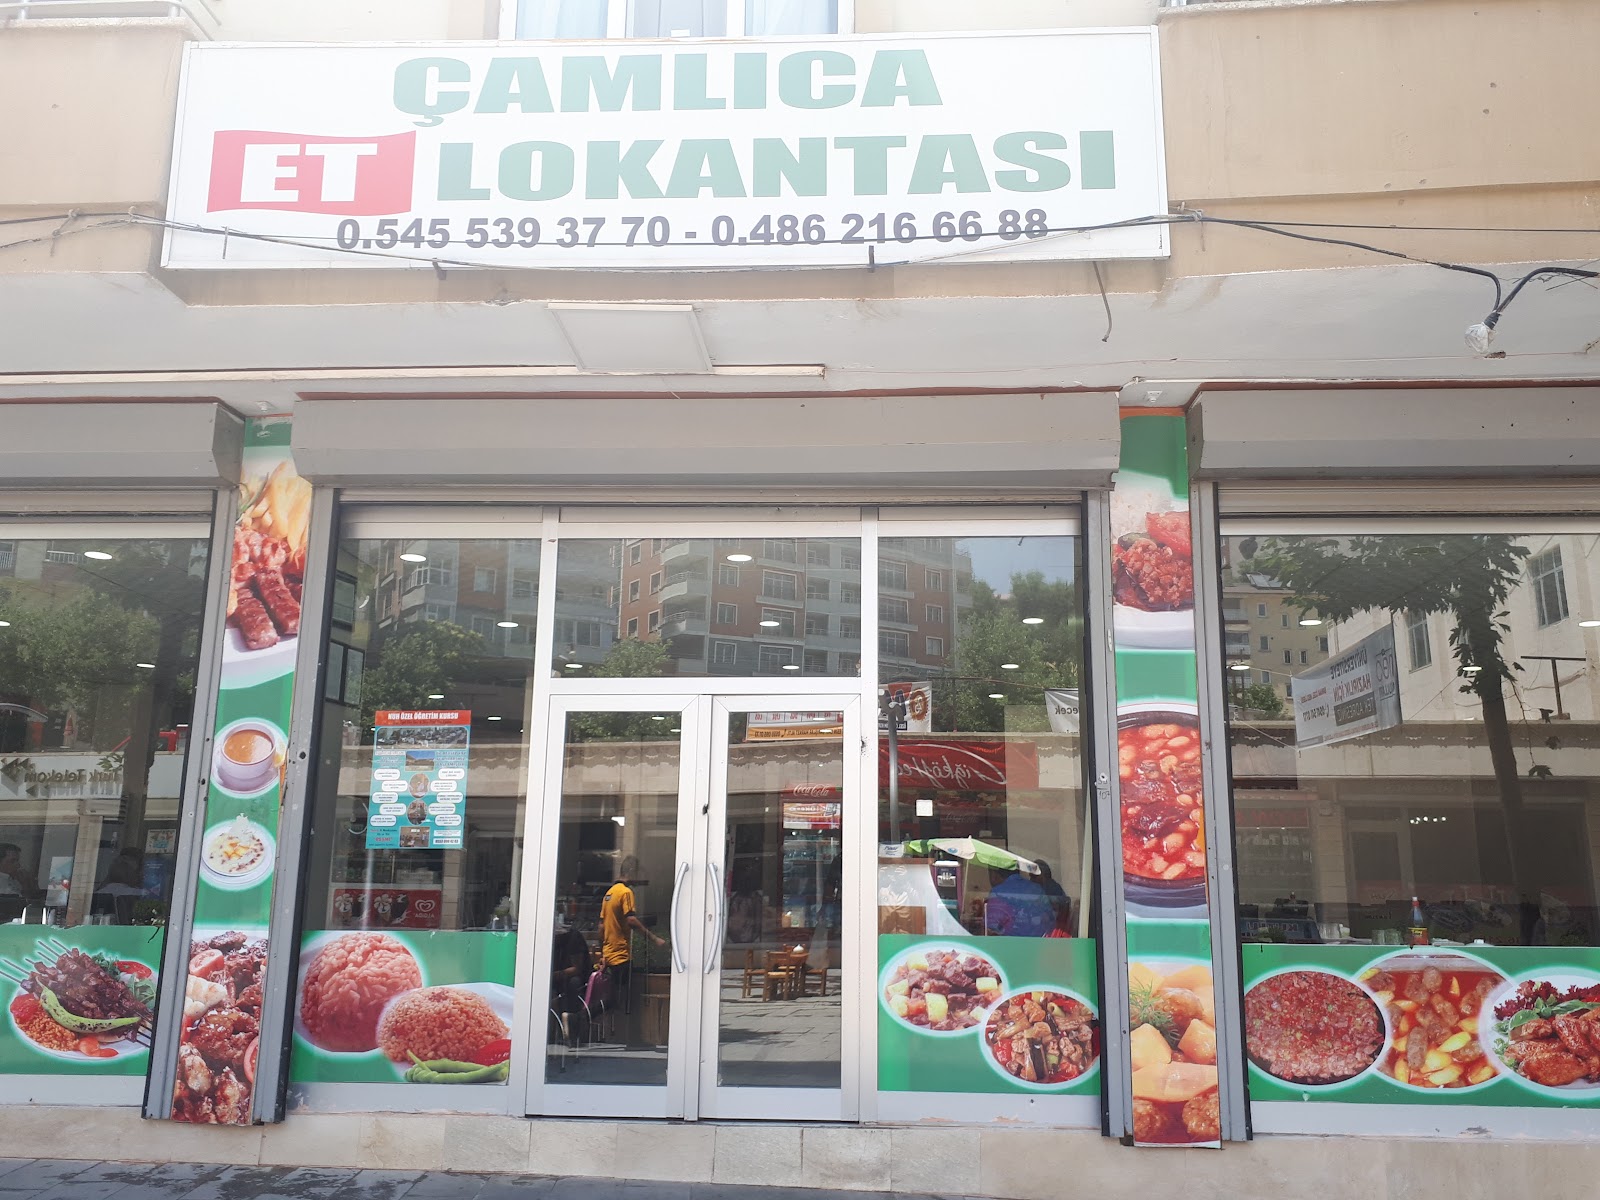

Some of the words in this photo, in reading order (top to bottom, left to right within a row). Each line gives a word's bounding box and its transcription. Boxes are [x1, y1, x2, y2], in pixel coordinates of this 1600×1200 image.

[393, 49, 943, 127] ÇAMLICA
[240, 143, 378, 203] ET
[437, 130, 1116, 201] LOKANTASI
[336, 218, 451, 249] 0.545
[465, 217, 541, 248] 539
[556, 216, 606, 248] 37
[621, 216, 670, 247] 70
[711, 214, 826, 246] 0.486
[840, 212, 917, 244] 216
[932, 210, 983, 243] 66
[998, 208, 1048, 240] 88
